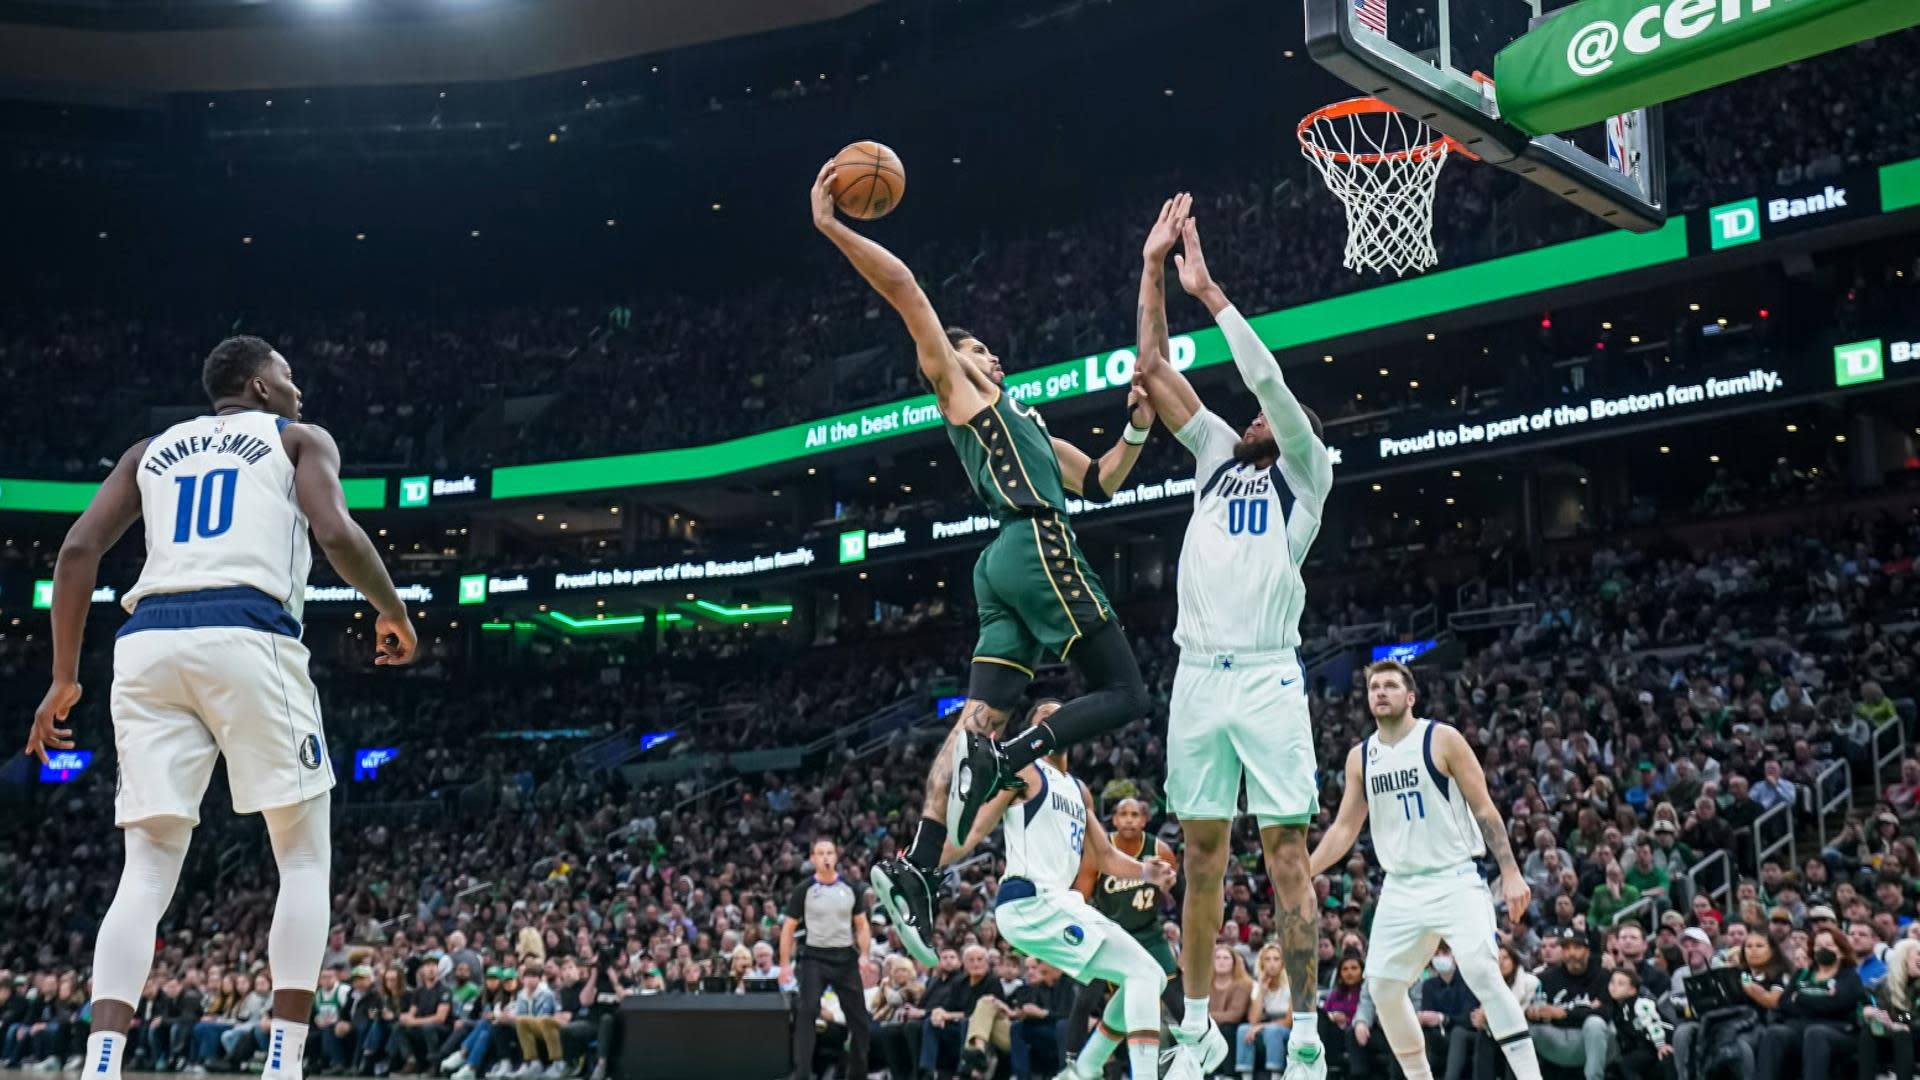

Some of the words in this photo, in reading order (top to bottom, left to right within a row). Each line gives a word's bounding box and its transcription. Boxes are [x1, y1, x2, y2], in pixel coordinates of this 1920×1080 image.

[1715, 208, 1755, 239] TD
[1768, 186, 1847, 222] Bank
[1839, 349, 1878, 377] TD
[805, 425, 827, 448] All
[830, 421, 857, 442] the
[861, 411, 898, 435] best
[1046, 370, 1079, 397] get
[1085, 335, 1196, 392] LOD
[1380, 430, 1436, 457] Proud
[1437, 429, 1458, 447] to
[1459, 424, 1485, 443] be
[1486, 415, 1530, 442] part
[1530, 407, 1552, 430] of
[1554, 404, 1589, 426] the
[1590, 391, 1664, 419] Boston
[1666, 384, 1704, 405] fan
[1705, 368, 1783, 398] family.
[145, 433, 272, 476] FINNEY-SMITH
[173, 468, 239, 543] 10
[403, 482, 427, 502] TD
[433, 476, 476, 496] Bank
[933, 516, 973, 539] Proud
[974, 516, 989, 531] to
[1137, 484, 1163, 502] fan
[1229, 499, 1268, 534] 00
[868, 528, 906, 549] Bank
[489, 575, 528, 592] Bank
[556, 573, 597, 589] Proud
[597, 571, 612, 585] to
[613, 568, 631, 585] be
[632, 565, 663, 585] part
[663, 563, 679, 580] of
[680, 562, 704, 579] the
[705, 561, 753, 577] Boston
[754, 555, 773, 572] fan
[1371, 769, 1418, 796] DALLAS
[1397, 791, 1424, 821] 77
[1132, 886, 1155, 911] 42
